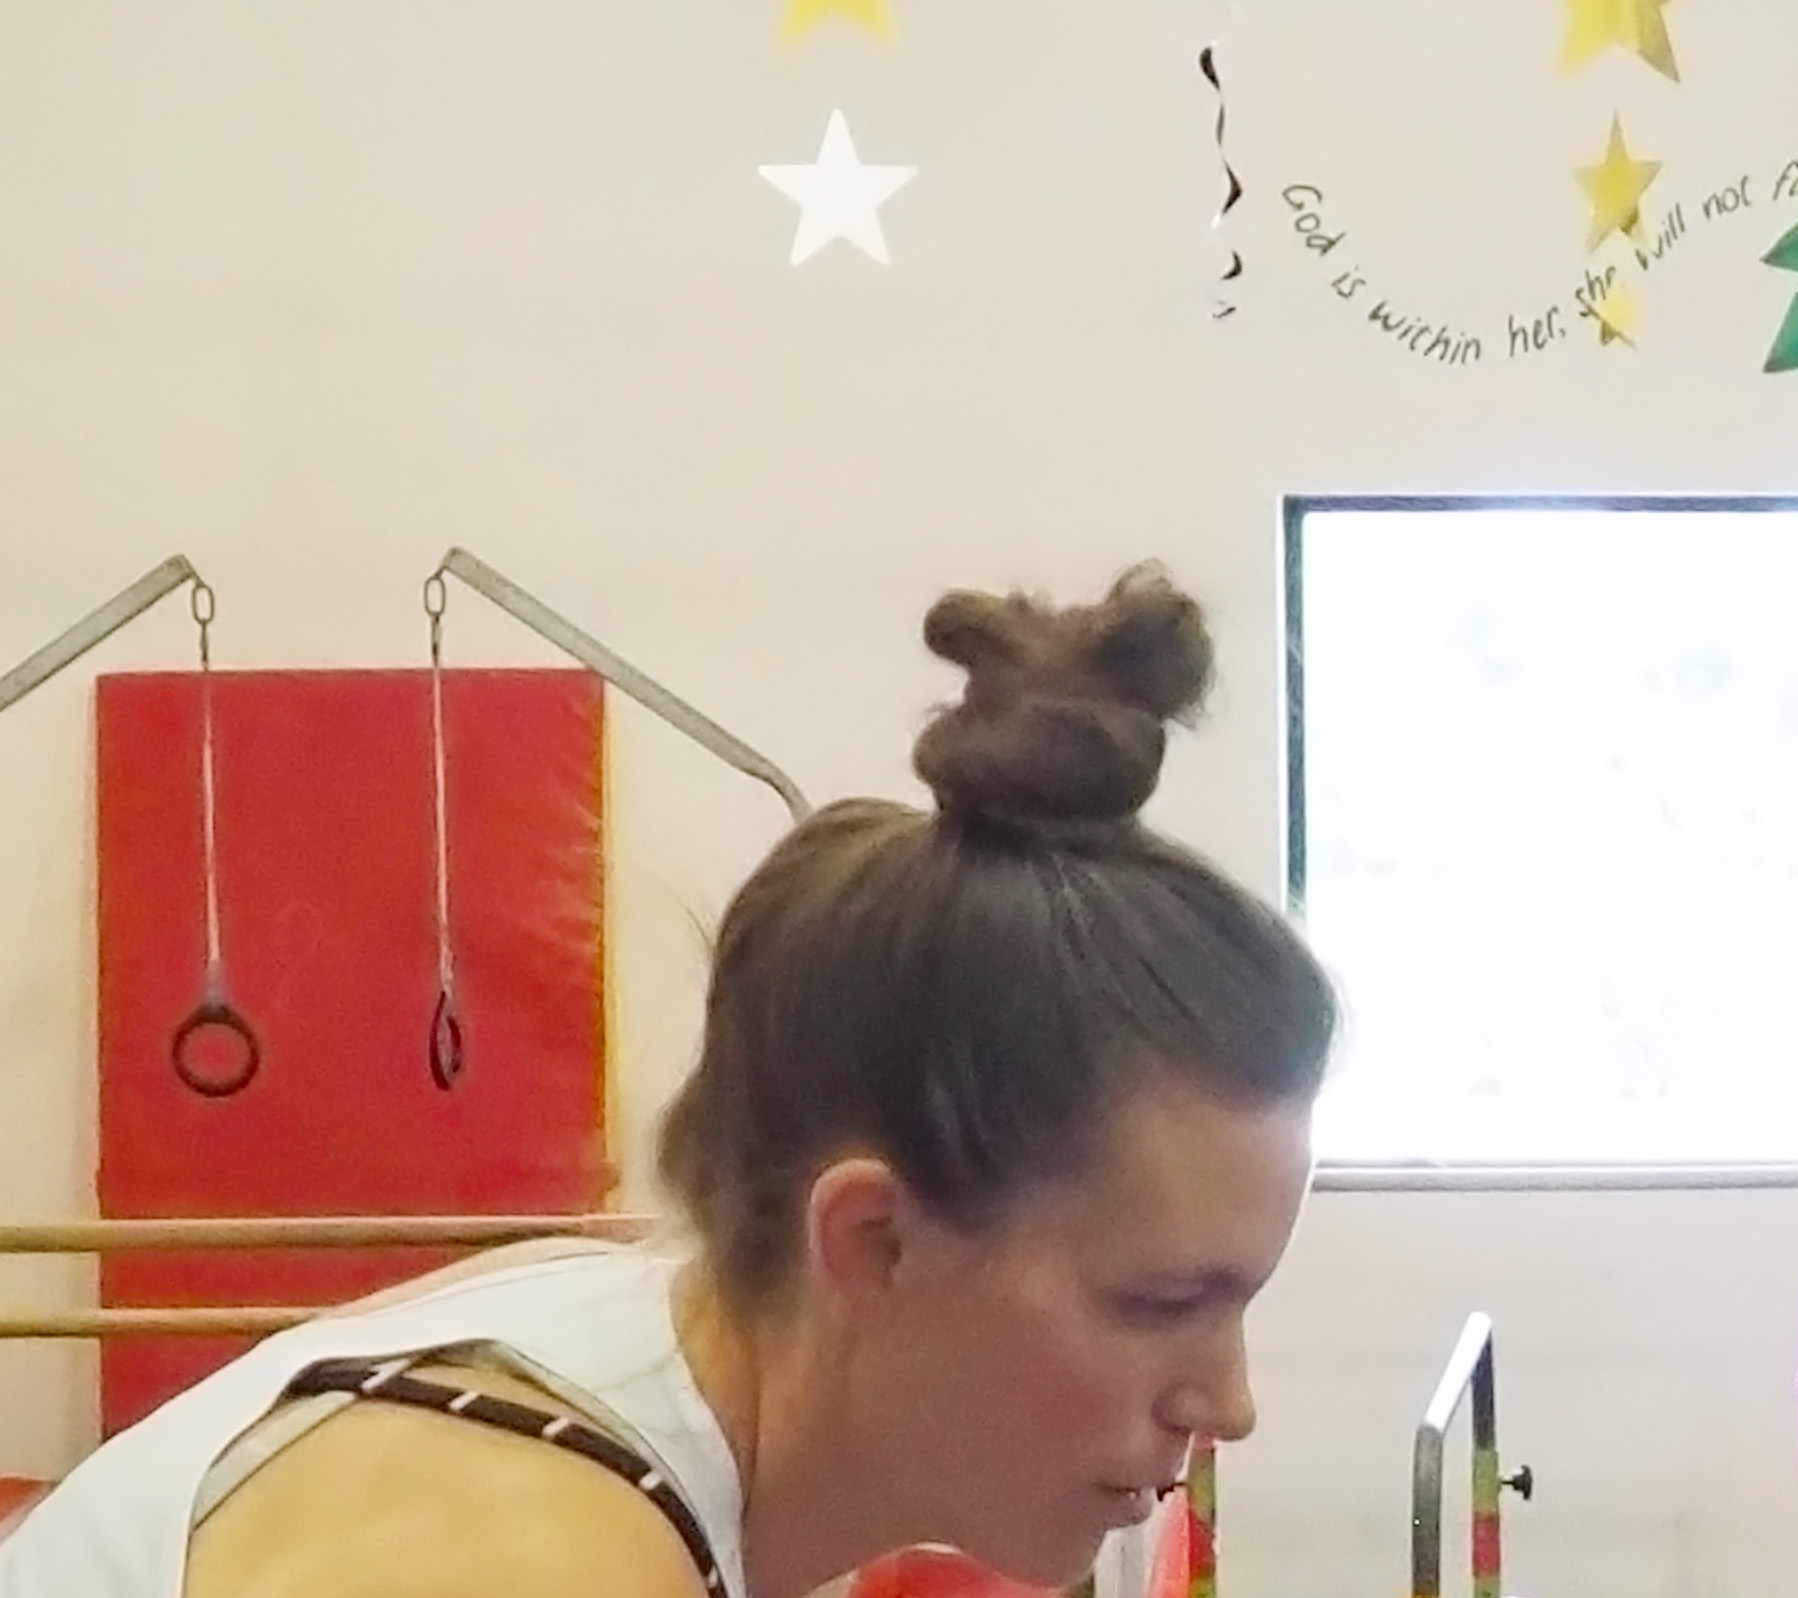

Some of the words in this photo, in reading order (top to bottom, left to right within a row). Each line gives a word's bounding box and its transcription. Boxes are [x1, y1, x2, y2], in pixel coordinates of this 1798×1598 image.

[1282, 184, 1346, 256] God
[1331, 265, 1366, 299] is
[1368, 300, 1481, 365] within
[1634, 202, 1686, 271] will
